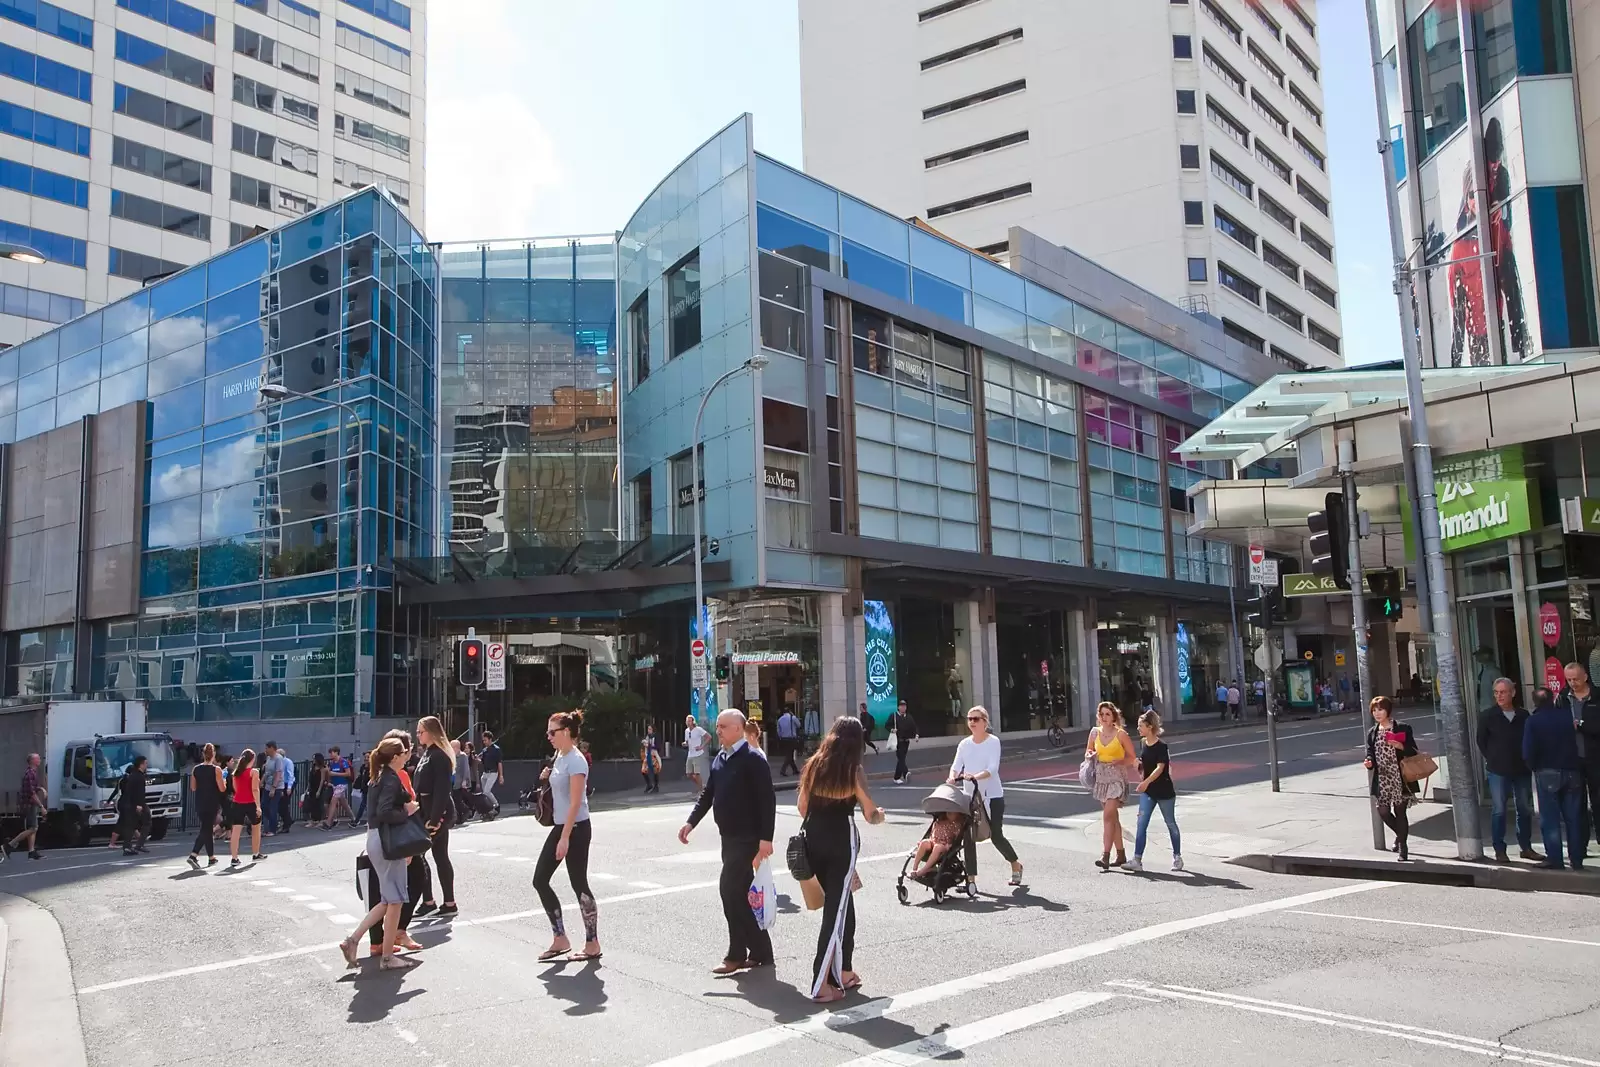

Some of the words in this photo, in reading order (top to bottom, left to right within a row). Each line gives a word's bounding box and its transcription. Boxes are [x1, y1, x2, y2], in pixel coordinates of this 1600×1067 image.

[685, 288, 700, 308] HART
[222, 381, 244, 399] HARRY
[1439, 494, 1508, 540] hmandu
[864, 638, 876, 656] THE
[876, 638, 892, 656] CULT
[490, 660, 501, 668] NO
[731, 652, 763, 663] General
[763, 651, 787, 662] Pants
[787, 651, 799, 662] Co.
[873, 682, 893, 702] DENIM
